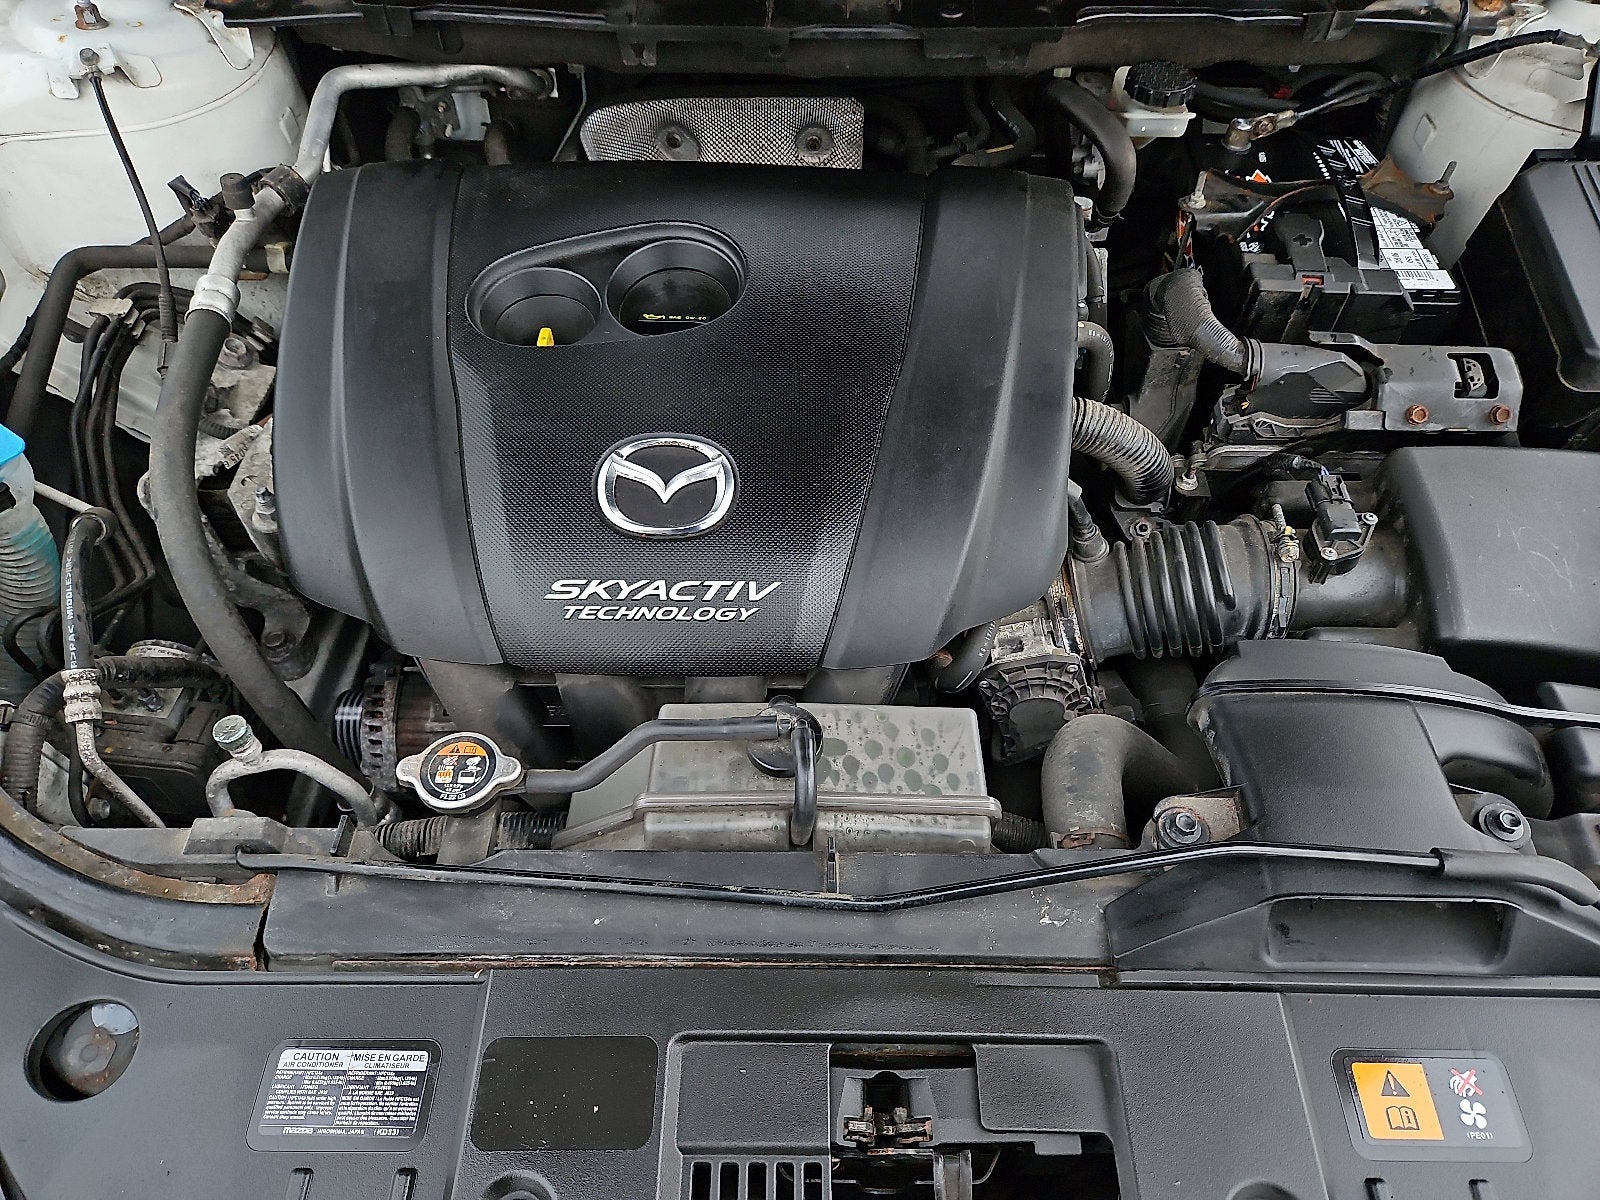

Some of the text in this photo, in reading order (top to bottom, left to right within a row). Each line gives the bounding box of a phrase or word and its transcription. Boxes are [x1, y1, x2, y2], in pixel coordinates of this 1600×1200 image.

[543, 579, 783, 602] SKYACTIV
[563, 605, 763, 622] TECHNOLOGY
[293, 1052, 340, 1061] CAUTION
[353, 1053, 426, 1063] MISE EN GARDE
[282, 1126, 314, 1135] mazda
